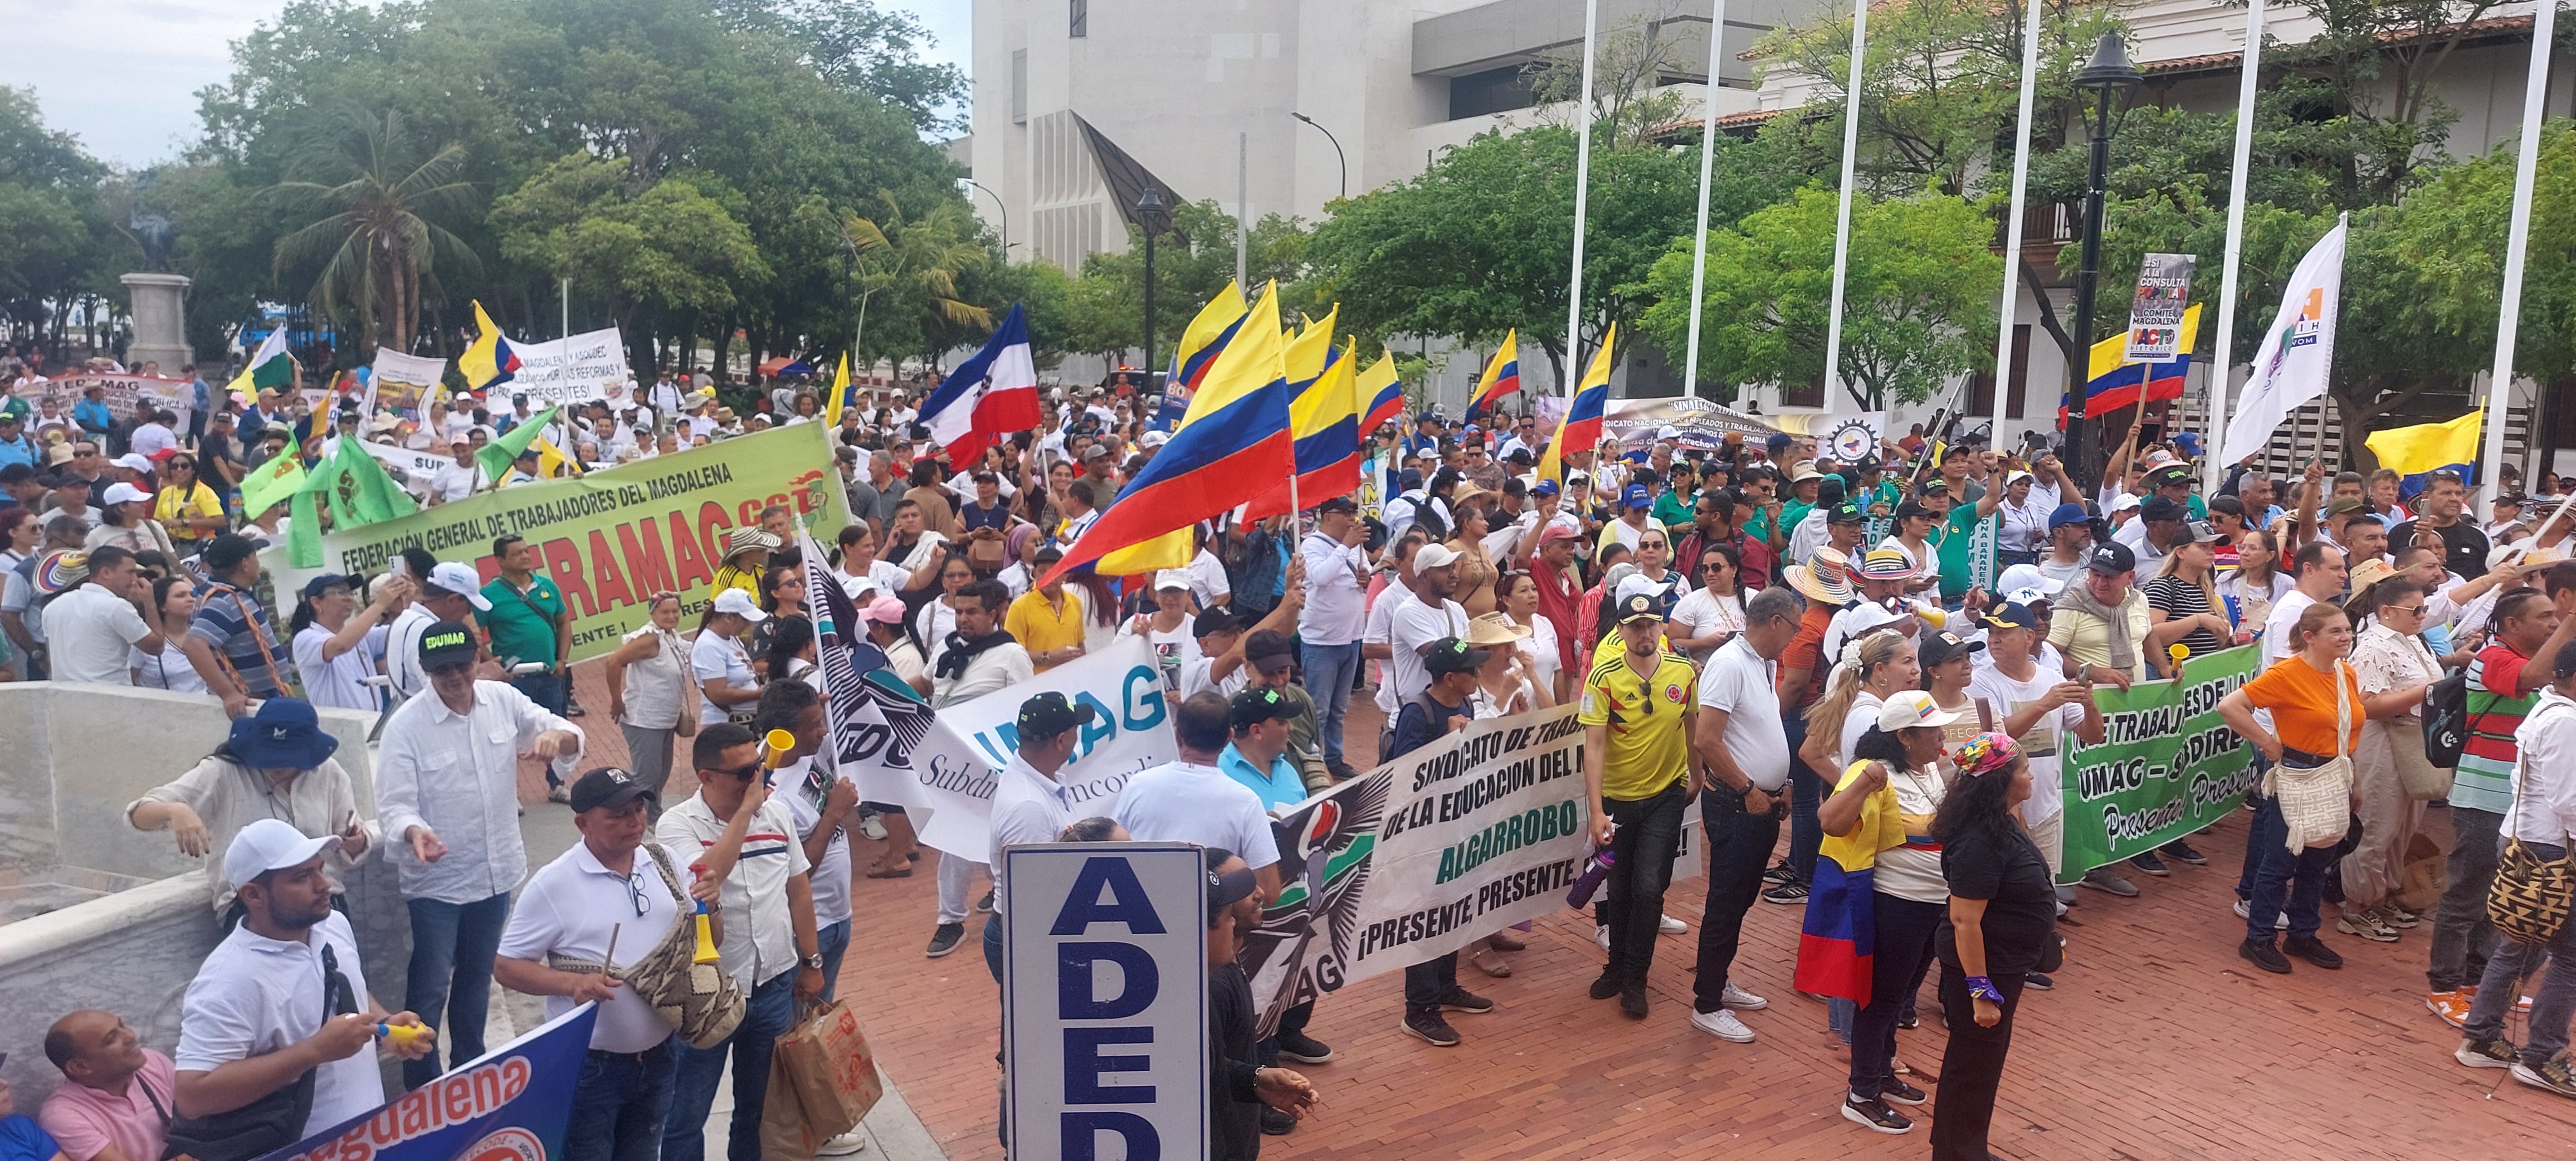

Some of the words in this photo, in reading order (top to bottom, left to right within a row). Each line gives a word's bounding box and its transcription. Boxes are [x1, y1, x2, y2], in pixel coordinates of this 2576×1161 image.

[2137, 286, 2186, 299] POPULAR
[2140, 278, 2186, 287] CONSULTA
[2133, 317, 2180, 325] MAGDALENA
[524, 354, 564, 368] MAGDALEN
[575, 364, 616, 379] REFORMAS
[427, 519, 487, 553] GENERAL
[486, 513, 508, 538] DE
[507, 487, 615, 533] TRABAJADORES
[618, 486, 647, 508] DEL
[648, 462, 734, 501] MAGDALENA
[425, 631, 465, 651] EDUMAG
[572, 623, 618, 647] ENTE
[1413, 730, 1504, 793] SINDICATO
[1504, 725, 1532, 754] DE
[1533, 712, 1587, 746] TRABA
[2079, 758, 2145, 801] UMAG
[1382, 806, 1408, 842] DE
[1408, 796, 1435, 830] LA
[1439, 757, 1536, 823] EDUCACION
[1539, 751, 1572, 783] DEL
[1435, 799, 1578, 886] ALGARROBO
[1357, 893, 1474, 962] ¡PRESENTE,
[1291, 954, 1345, 1004] AG
